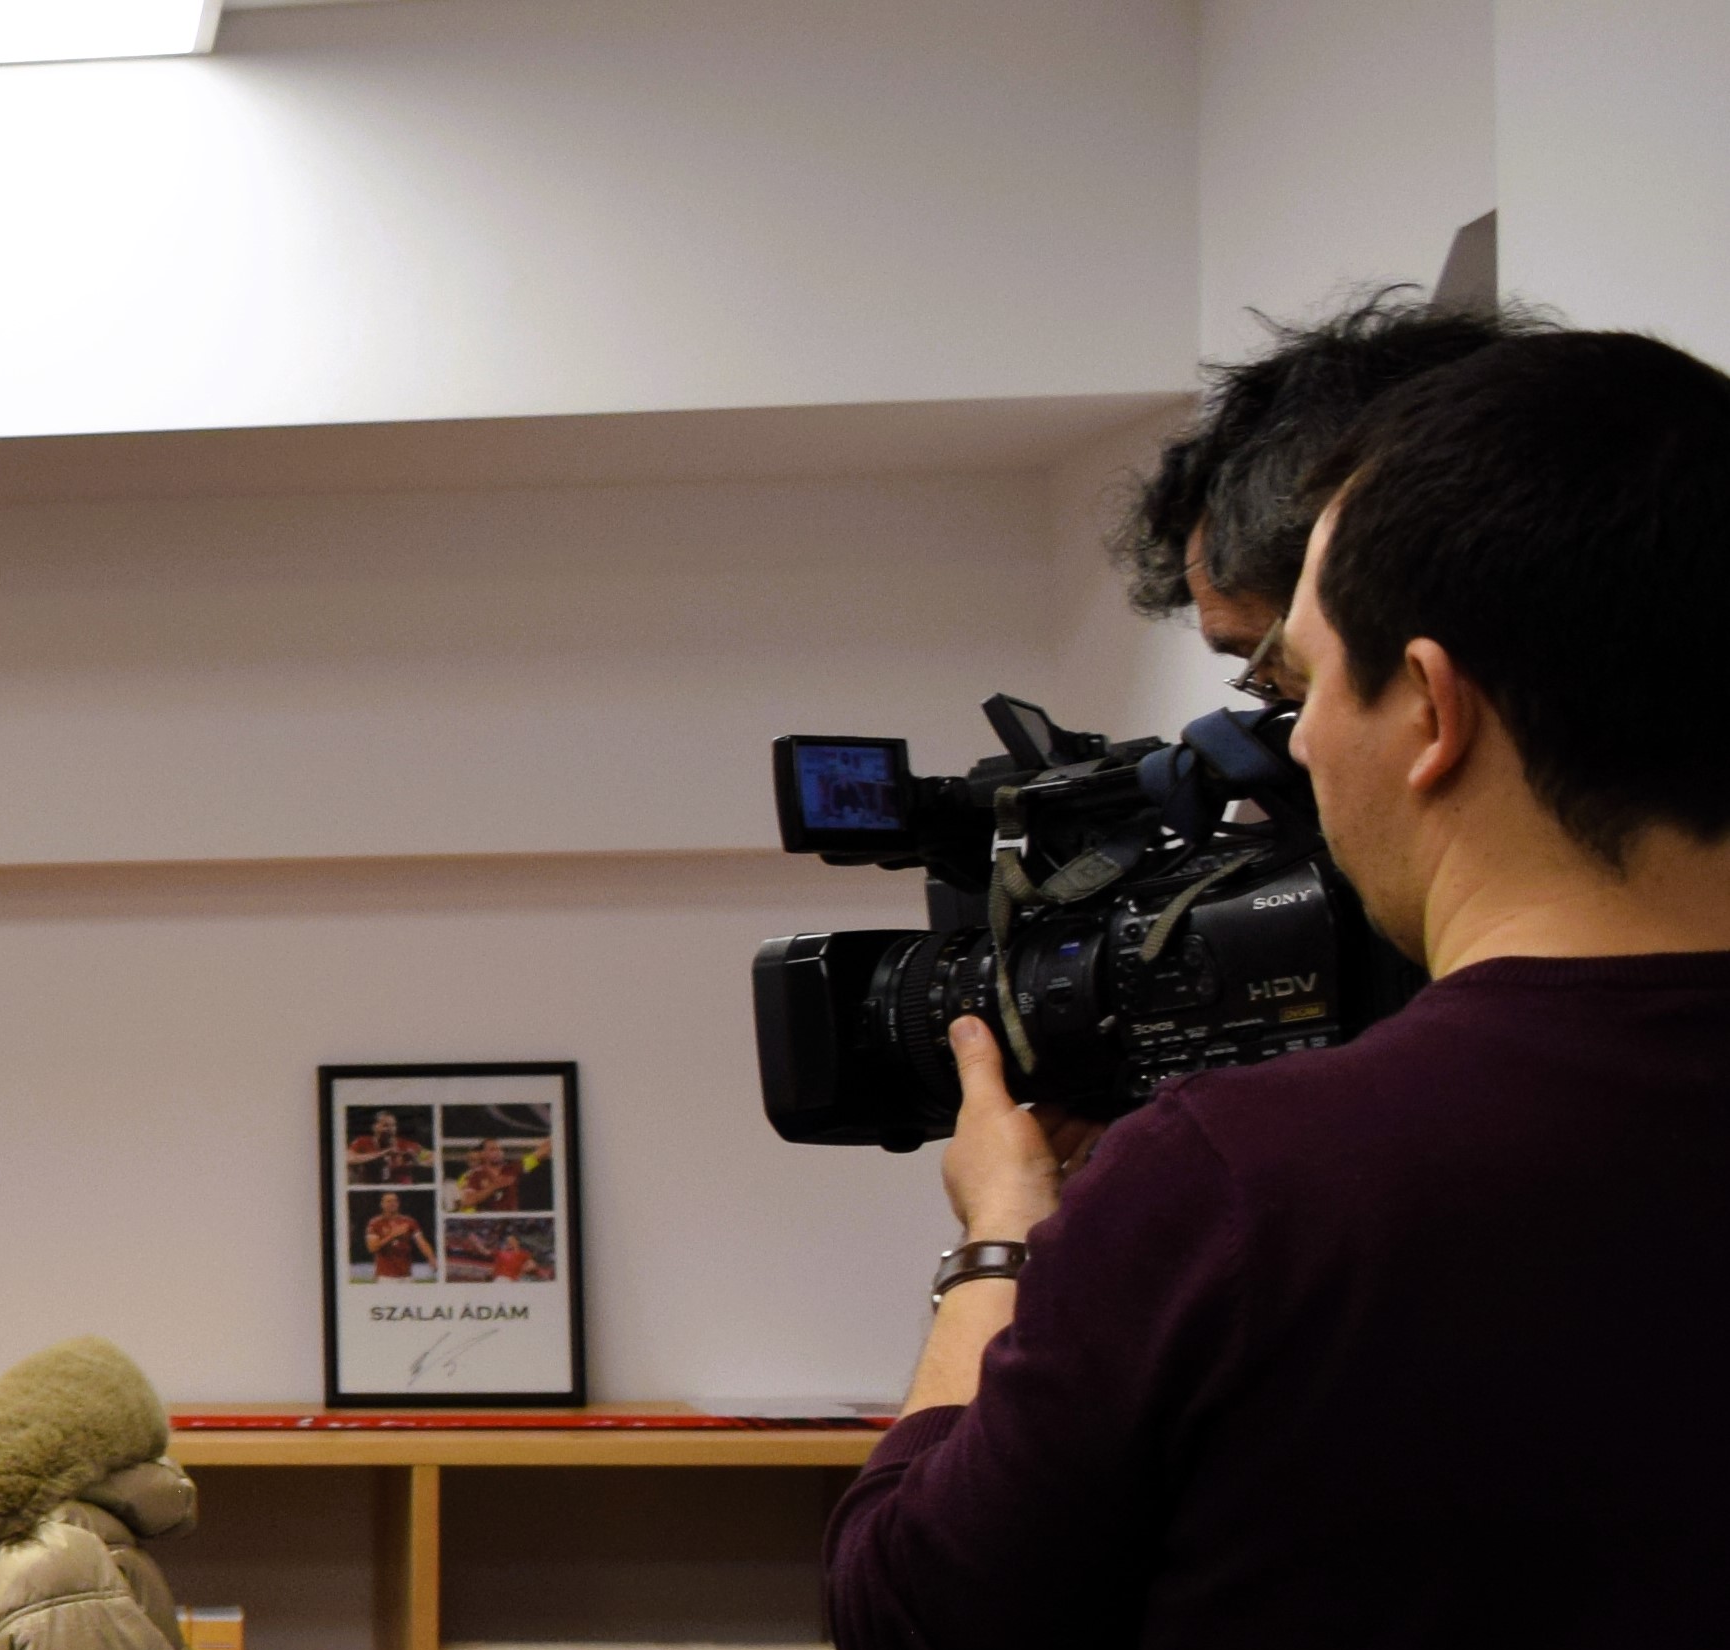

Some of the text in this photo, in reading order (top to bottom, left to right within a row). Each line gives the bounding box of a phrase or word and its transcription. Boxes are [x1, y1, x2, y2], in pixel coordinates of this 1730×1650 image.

[1252, 888, 1313, 911] SONY
[1247, 972, 1318, 1001] HDV
[370, 1303, 529, 1321] SZALAI ÁDÁM
